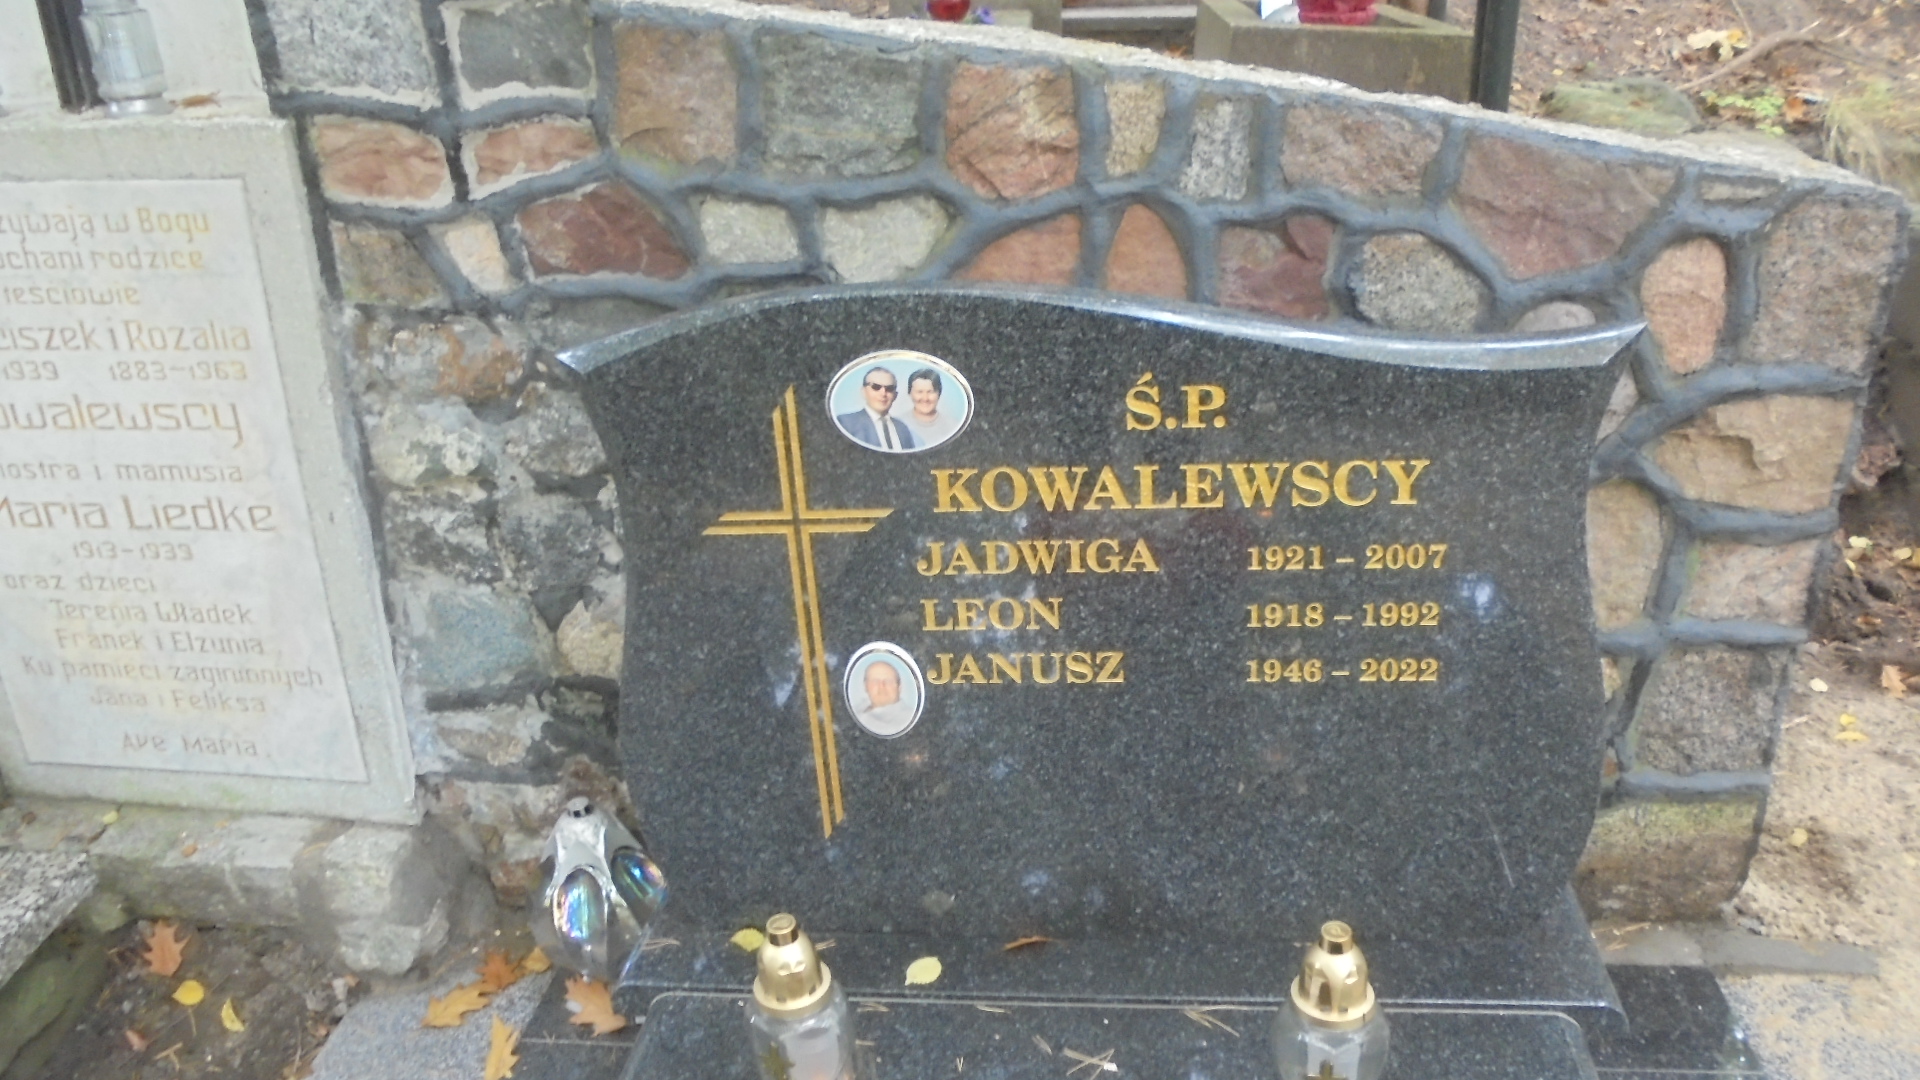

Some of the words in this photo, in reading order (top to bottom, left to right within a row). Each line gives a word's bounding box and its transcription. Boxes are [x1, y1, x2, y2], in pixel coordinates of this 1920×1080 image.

[103, 213, 130, 233] w
[136, 206, 211, 243] Bogu
[0, 246, 84, 270] chani
[90, 245, 205, 270] rodzice
[123, 319, 251, 351] Rozalia
[3, 360, 59, 381] 1939
[1125, 371, 1228, 431] Ś.P.
[115, 462, 243, 483] mamusia
[930, 458, 1431, 513] KOWALEWSCY
[121, 494, 276, 532] Liedke
[916, 538, 1160, 576] JADWIGA
[1246, 545, 1325, 571] 1921
[1365, 543, 1448, 570] 2007
[4, 574, 66, 590] oraz
[78, 570, 156, 593] dzieci
[49, 598, 147, 623] Terenia
[920, 597, 1063, 632] LEON
[1246, 602, 1326, 628] 1918
[1363, 602, 1440, 627] 1992
[54, 628, 145, 651] Franek
[21, 655, 54, 677] Ku
[927, 651, 1126, 685] JANUSZ
[1246, 658, 1324, 683] 1946
[1360, 657, 1439, 683] 2022
[171, 689, 267, 713] Feliksa
